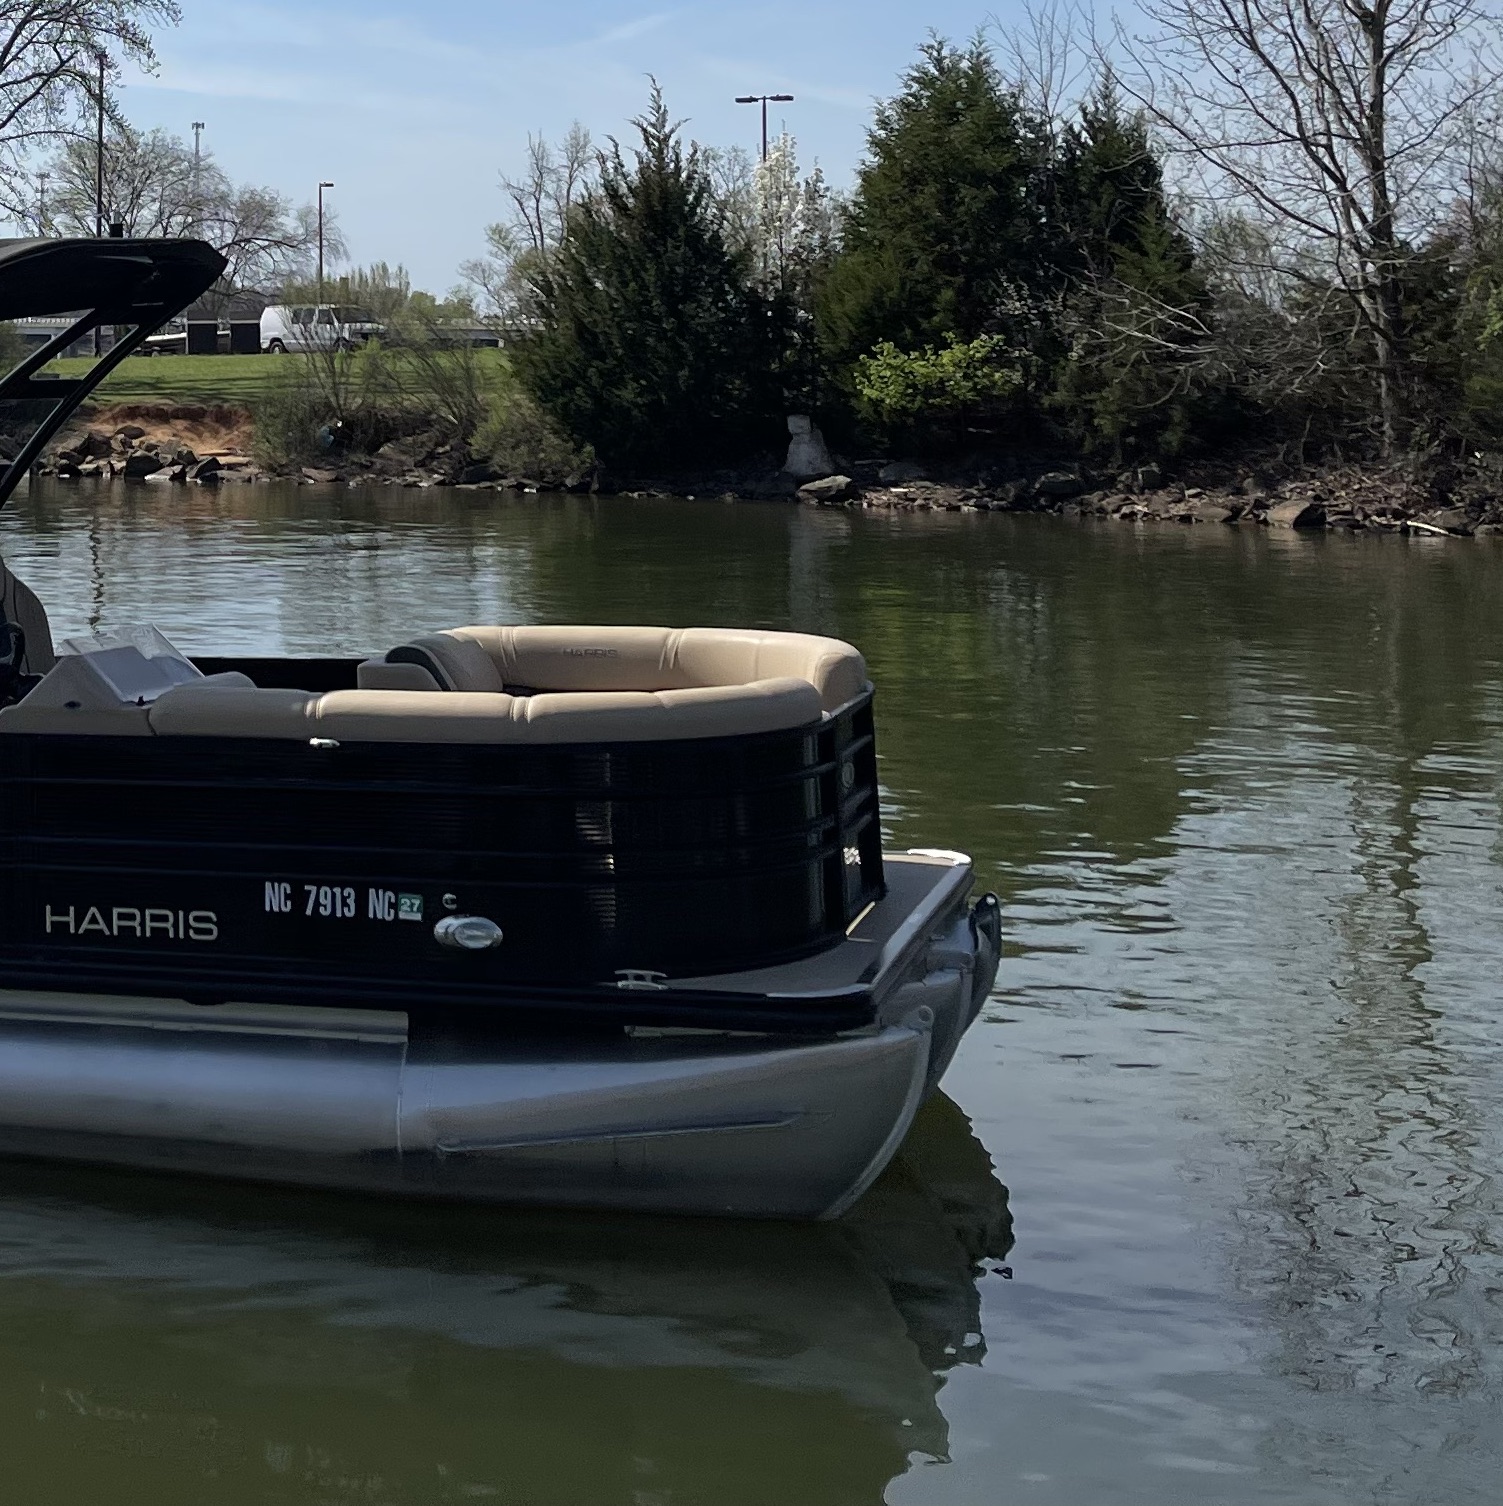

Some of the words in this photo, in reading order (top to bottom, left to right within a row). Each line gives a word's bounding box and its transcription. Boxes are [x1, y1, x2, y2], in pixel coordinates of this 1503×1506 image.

[264, 881, 292, 912] NC
[304, 884, 356, 917] 7913
[368, 888, 396, 921] NC
[398, 897, 421, 912] 27
[45, 903, 219, 942] HARRIS
